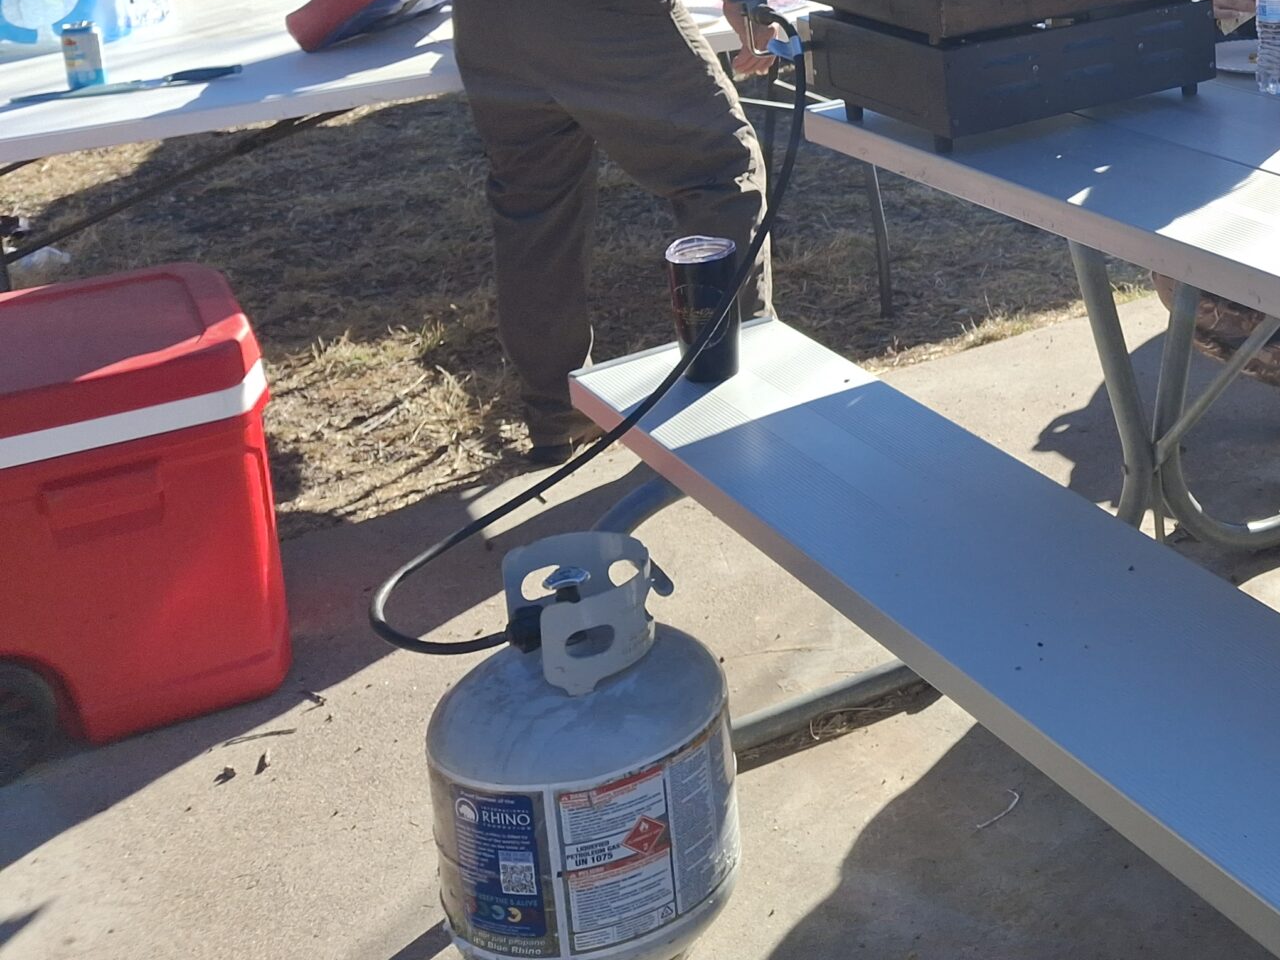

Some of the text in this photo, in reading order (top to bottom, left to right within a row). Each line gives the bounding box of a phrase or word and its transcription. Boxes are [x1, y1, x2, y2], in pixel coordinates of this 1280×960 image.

[482, 810, 530, 825] RHINO
[567, 842, 620, 860] PETROLEUM GAS
[575, 853, 613, 867] UN 1075
[488, 941, 508, 951] Blue
[512, 946, 541, 955] Rhino
